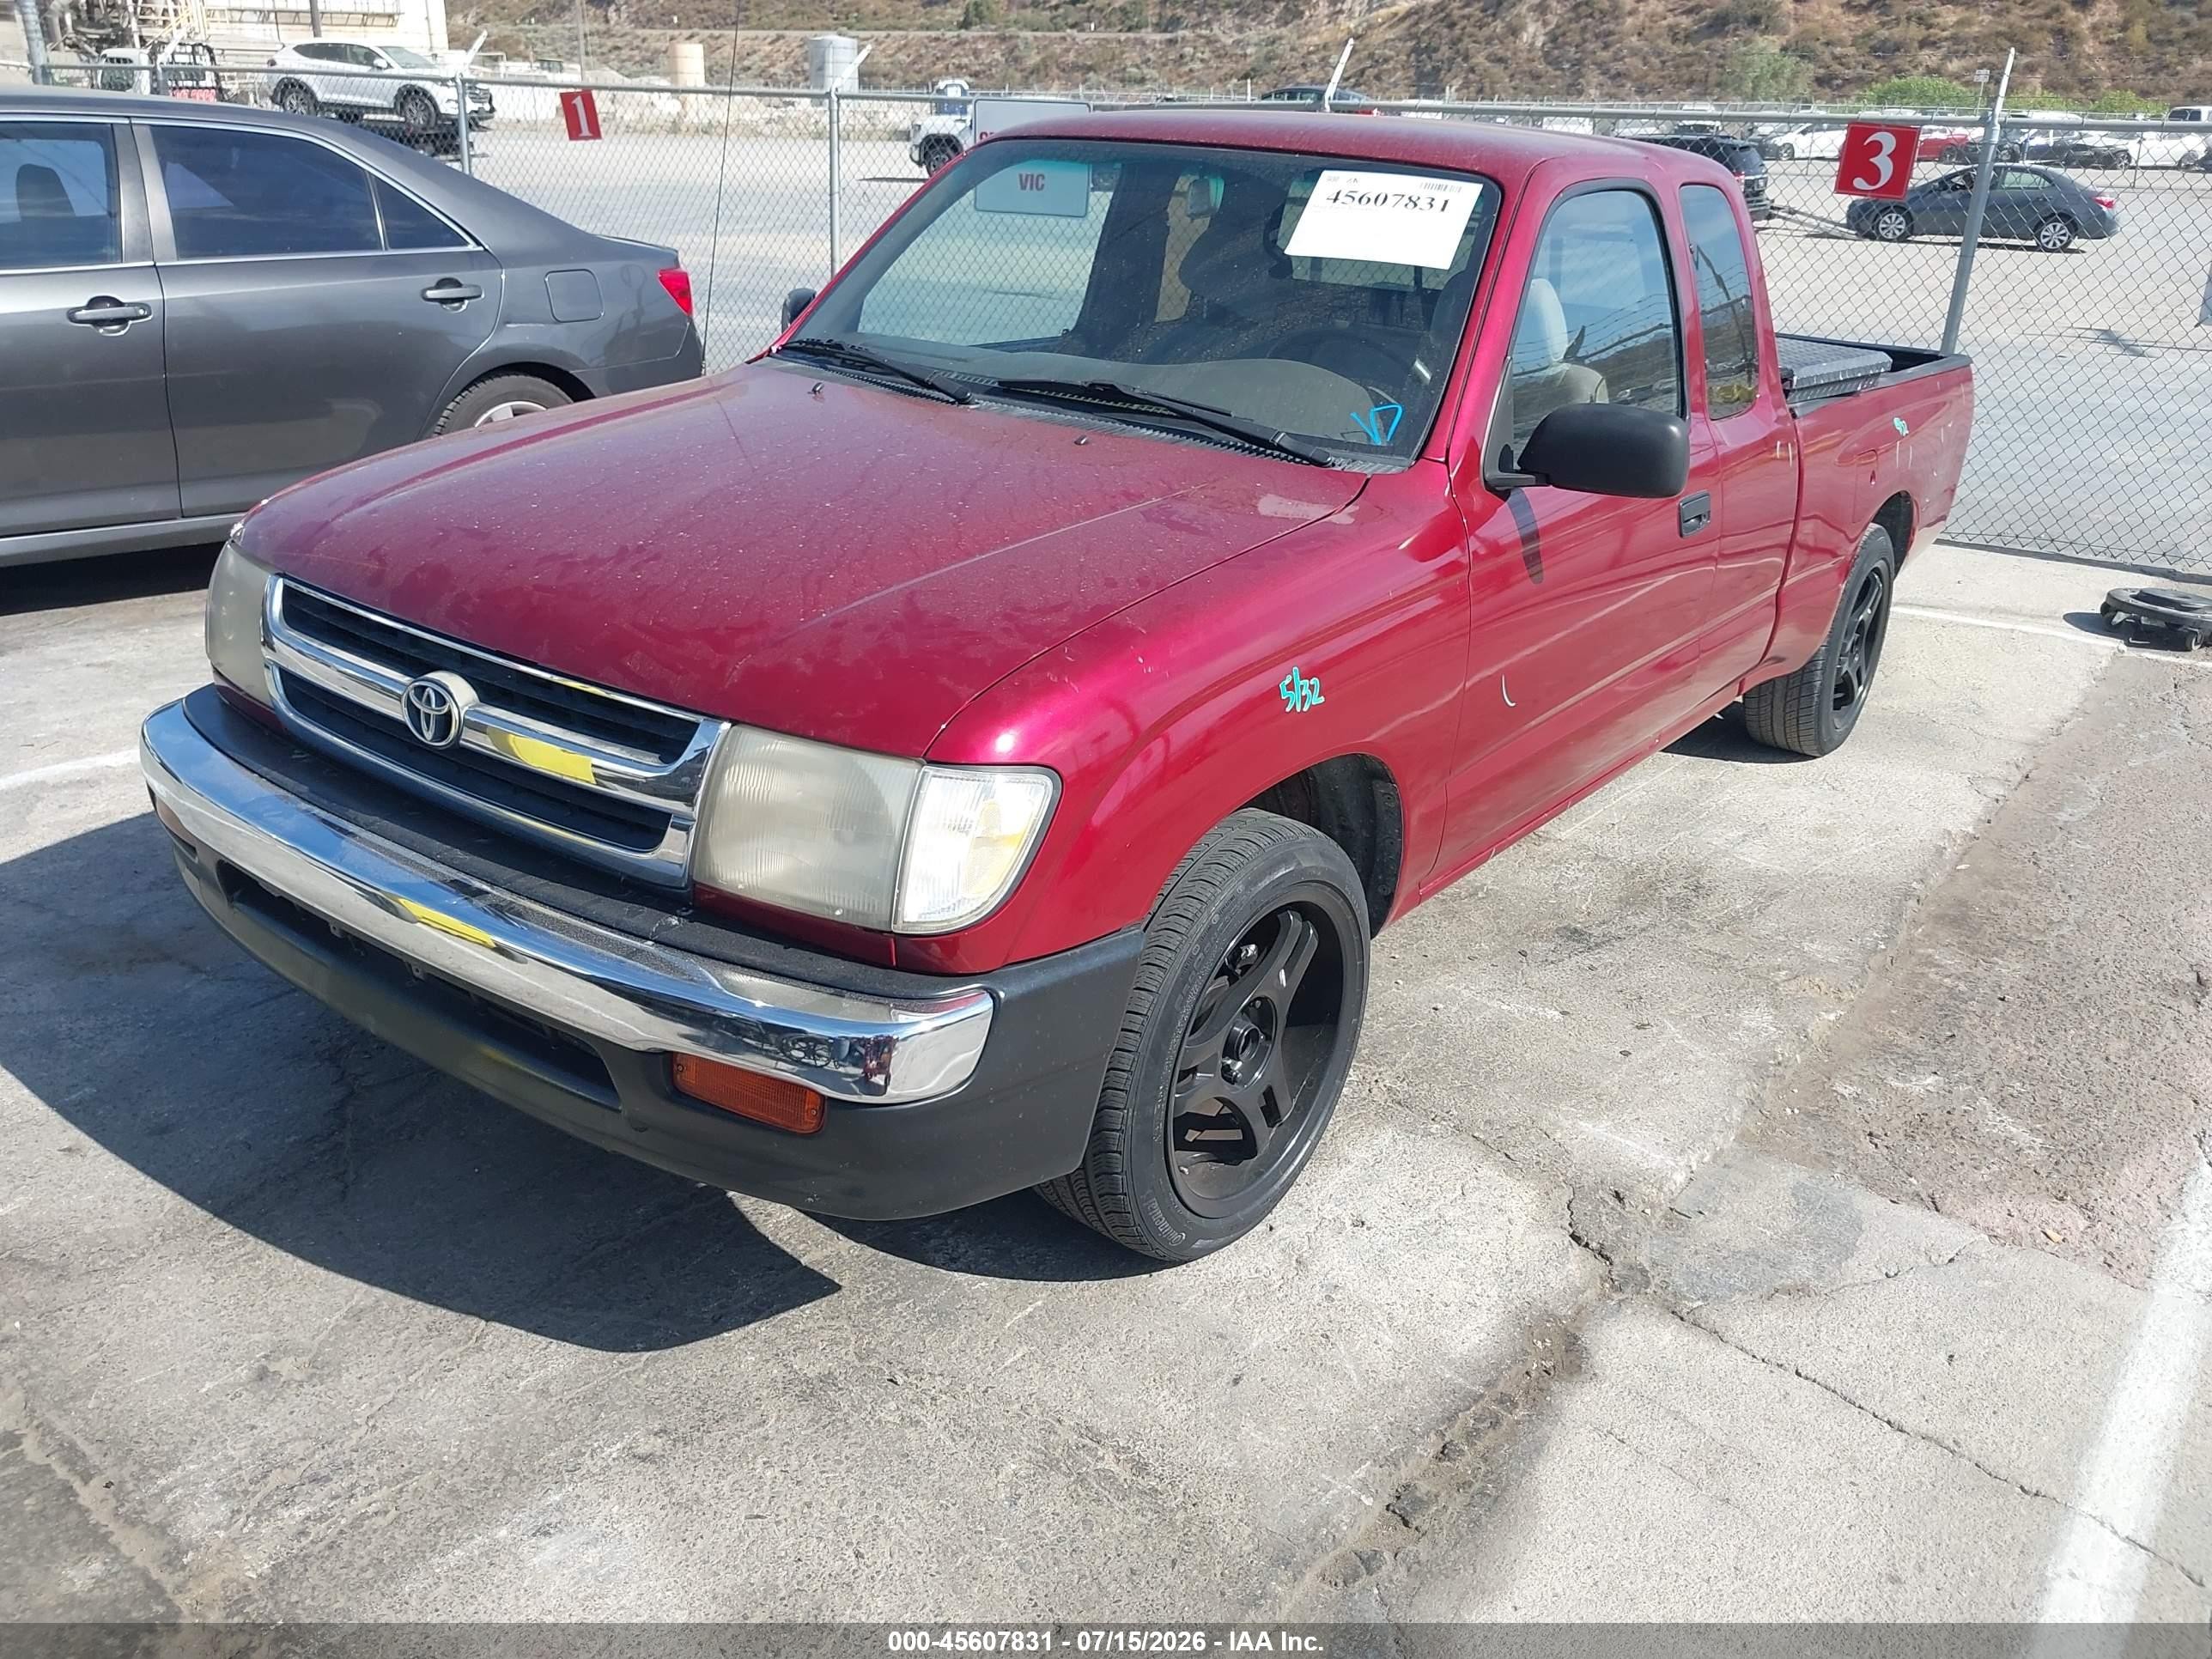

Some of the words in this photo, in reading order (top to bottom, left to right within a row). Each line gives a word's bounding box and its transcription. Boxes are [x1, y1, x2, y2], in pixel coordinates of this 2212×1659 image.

[570, 95, 593, 137] 1
[1852, 131, 1897, 191] 3
[1018, 173, 1045, 191] VIC
[1326, 189, 1449, 213] 45607831
